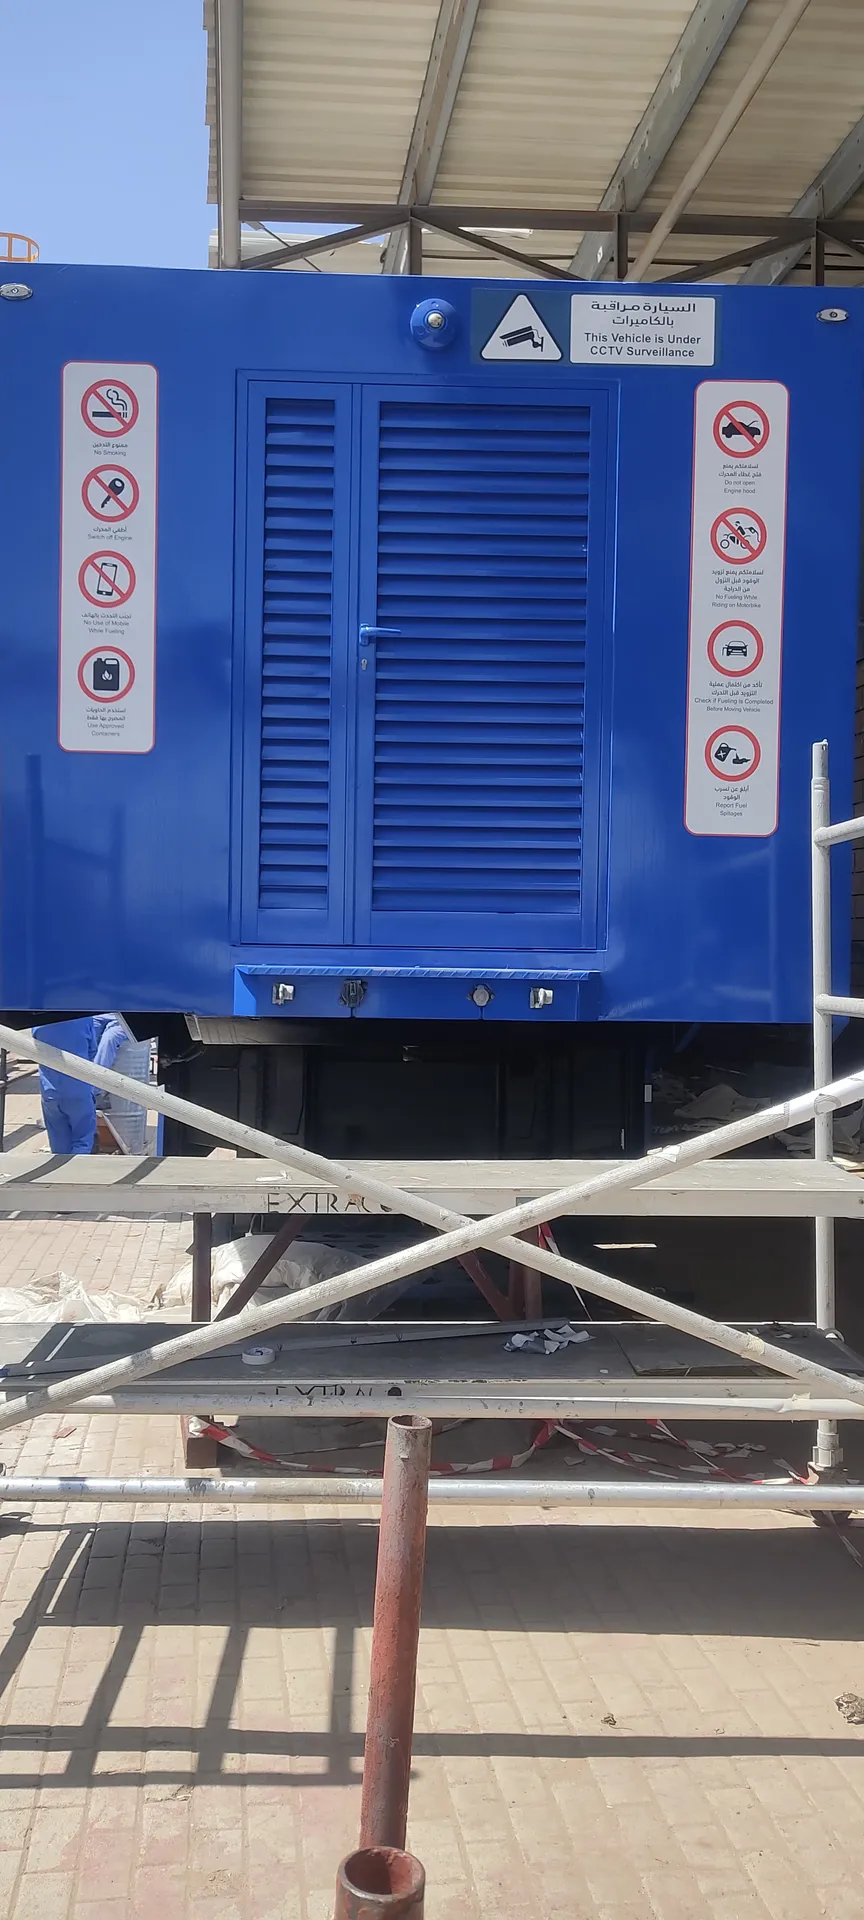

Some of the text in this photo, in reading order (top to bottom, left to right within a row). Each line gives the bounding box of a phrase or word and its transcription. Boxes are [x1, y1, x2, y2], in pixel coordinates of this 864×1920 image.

[591, 301, 696, 314] السيارة مراقبة
[612, 316, 674, 328] بالكاميرات
[584, 332, 701, 344] This Vehicle is Under
[590, 346, 695, 357] CCTV Surveillance
[267, 1192, 393, 1213] EXTRAC
